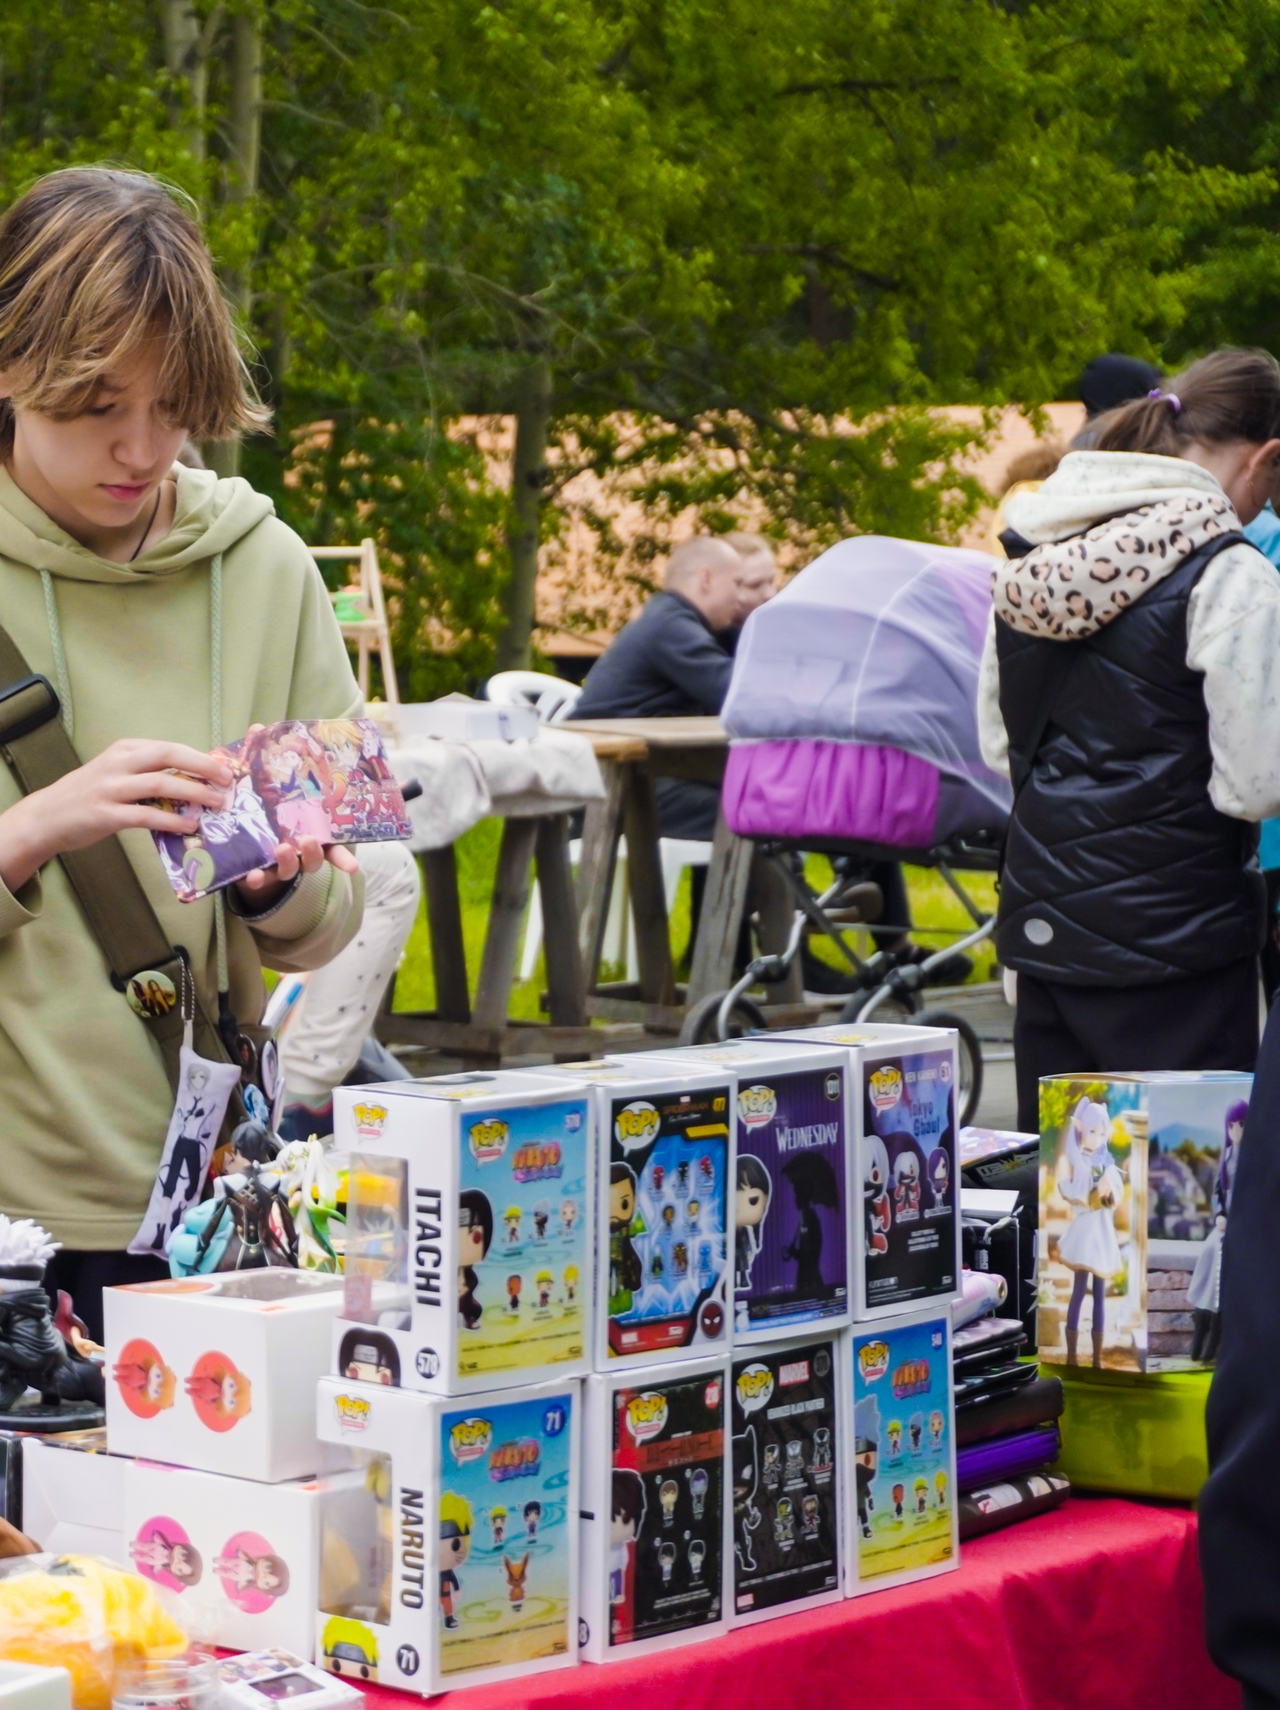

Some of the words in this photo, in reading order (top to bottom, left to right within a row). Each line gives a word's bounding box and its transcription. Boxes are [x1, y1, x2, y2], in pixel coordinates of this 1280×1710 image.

[869, 1068, 902, 1100] POP!
[941, 1065, 950, 1078] 61
[351, 1101, 389, 1127] POP!
[737, 1087, 776, 1117] POP!
[469, 1118, 510, 1150] POP!
[616, 1108, 660, 1141] POP!
[775, 1121, 839, 1153] WEDNESDAY
[415, 1187, 442, 1307] ITACHI
[417, 1351, 439, 1376] 578
[858, 1341, 890, 1372] POP!
[737, 1370, 773, 1405] POP!
[334, 1396, 371, 1421] POP!
[545, 1411, 562, 1432] 71
[626, 1394, 667, 1428] POP!
[449, 1418, 493, 1450] POP!
[399, 1486, 425, 1610] NARUTO
[399, 1648, 417, 1672] 71
